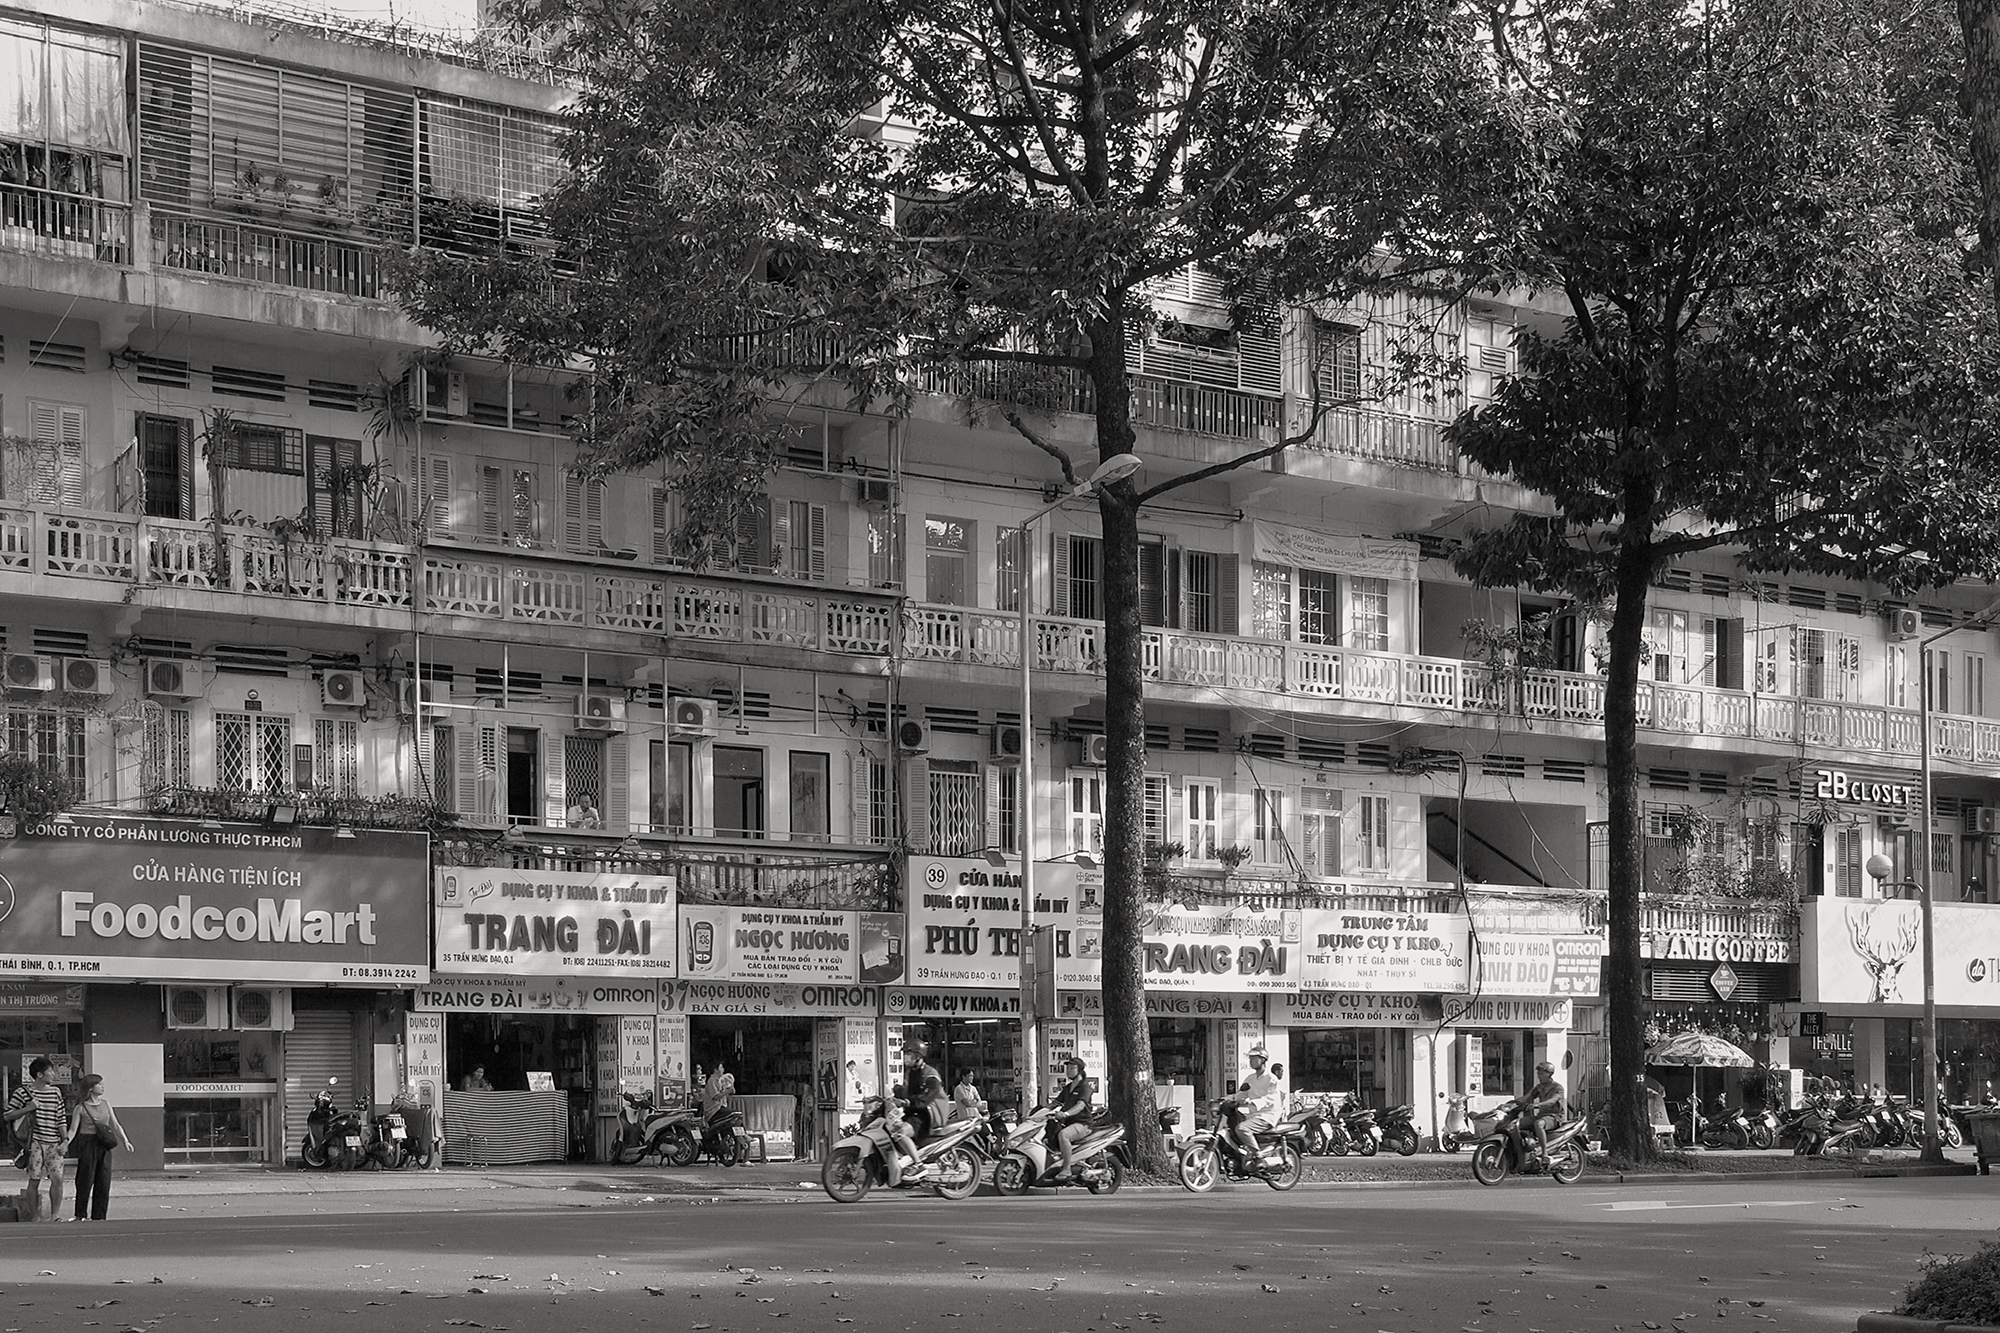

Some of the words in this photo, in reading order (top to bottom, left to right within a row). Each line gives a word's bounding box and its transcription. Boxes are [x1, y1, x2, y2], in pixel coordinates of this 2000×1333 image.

[1817, 769, 1848, 799] 2B
[1850, 781, 1912, 805] CLOSET
[25, 820, 68, 837] CÔNG
[71, 826, 91, 838] TY
[94, 820, 115, 839] CỔ
[118, 823, 158, 841] PHẦN
[160, 829, 210, 844] LƯƠNG
[213, 831, 251, 848] THỰC
[253, 834, 302, 848] TP.HCM
[132, 858, 170, 882] CỬA
[174, 862, 225, 884] HÀNG
[229, 865, 268, 888] TIỆN
[272, 866, 302, 887] ÍCH
[927, 868, 945, 883] 39
[959, 867, 989, 887] CỬA
[992, 871, 1023, 888] HÀN
[501, 882, 534, 901] DỤNG
[536, 884, 553, 902] CỤ
[555, 885, 565, 900] Y
[567, 885, 599, 901] KHOA
[601, 886, 612, 902] &
[649, 885, 668, 904] MỸ
[923, 894, 953, 911] DỤNG
[955, 895, 970, 913] CỤ
[972, 895, 980, 909] Y
[981, 896, 1010, 911] KHOA
[1011, 897, 1020, 912] &
[1052, 896, 1069, 914] MỸ
[60, 890, 378, 946] FoodcoMart
[741, 912, 763, 925] DỤNG
[763, 913, 774, 925] CỤ
[775, 914, 781, 924] Y
[781, 914, 802, 925] KHOA
[802, 915, 809, 926] &
[832, 914, 844, 926] MỸ
[1340, 915, 1394, 930] TRUNG
[1395, 914, 1429, 932] TÂM
[463, 912, 579, 953] TRANG
[597, 908, 652, 955] ĐÀI
[925, 917, 980, 956] PHÚ
[735, 928, 784, 953] NGỌC
[790, 928, 850, 951] HƯƠNG
[1317, 933, 1365, 952] DỤNG
[1366, 935, 1389, 953] CỤ
[1392, 936, 1404, 950] Y
[1518, 942, 1524, 955] Y
[1526, 942, 1550, 956] KHOA
[1555, 941, 1600, 956] OMRON
[1714, 937, 1790, 963] COFFEE
[442, 953, 452, 963] 35
[471, 953, 489, 964] HƯNG
[743, 953, 759, 962] MUA
[760, 953, 776, 962] BÁN
[777, 955, 797, 963] TRAO
[798, 953, 811, 963] ĐỔI
[1236, 938, 1287, 976] ĐÀI
[1306, 952, 1331, 965] THIẾT
[1335, 955, 1344, 966] BỊ
[1347, 956, 1353, 965] Y
[1371, 956, 1386, 966] GIA
[1421, 957, 1442, 967] CHLB
[1446, 956, 1463, 968] ĐỨC
[21, 958, 45, 971] BÌNH,
[68, 961, 100, 972] TP.HCM
[747, 961, 762, 970] CÁC
[763, 963, 780, 972] LOẠI
[781, 963, 801, 973] DỤNG
[801, 964, 812, 973] CỤ
[1516, 958, 1549, 983] ĐÀO
[342, 967, 357, 977] ĐT:
[358, 967, 393, 978] 08.3914
[394, 969, 417, 979] 2242
[917, 967, 929, 979] 39
[950, 970, 970, 980] HƯNG
[970, 971, 986, 982] ĐẠO
[444, 978, 455, 988] CỤ
[463, 978, 485, 987] KHOA
[1258, 980, 1271, 988] 090
[1271, 980, 1285, 988] 3003
[1286, 981, 1297, 989] 565
[1303, 980, 1312, 989] 43
[25, 993, 59, 1006] TRƯỜNG
[421, 991, 485, 1007] TRANG
[490, 988, 523, 1008] ĐÀI
[593, 987, 655, 1003] OMRON
[661, 980, 690, 1012] 37
[690, 984, 725, 1001] NGỌC
[727, 983, 771, 999] HƯƠNG
[801, 985, 876, 1007] OMRON
[1286, 993, 1334, 1010] DỤNG
[1338, 994, 1361, 1010] CỤ
[1365, 995, 1377, 1009] Y
[691, 1001, 720, 1013] BÁN
[724, 1002, 749, 1013] GIÁ
[890, 994, 904, 1007] 39
[909, 995, 940, 1015] DỤNG
[942, 995, 958, 1015] CỤ
[959, 996, 969, 1011] Y
[970, 997, 1000, 1012] KHOA
[1001, 1001, 1009, 1012] &
[1194, 997, 1232, 1014] ĐÀI
[1241, 1000, 1258, 1013] 41
[1292, 1011, 1313, 1020] MUA
[1315, 1010, 1334, 1020] BÁN
[1342, 1012, 1364, 1021] TRAO
[1367, 1010, 1382, 1021] ĐỔI
[1390, 1011, 1402, 1021] KÝ
[1447, 1004, 1461, 1018] 45
[1465, 1001, 1493, 1024] DỤNG
[1496, 1002, 1510, 1025] CỤ
[1513, 1002, 1520, 1020] Y
[1523, 1002, 1550, 1021] KHOA
[1806, 1013, 1817, 1024] THE
[409, 1017, 429, 1030] DỤNG
[430, 1017, 440, 1030] CỤ
[623, 1020, 642, 1032] DỤNG
[642, 1020, 652, 1032] CỤ
[1803, 1024, 1820, 1035] ALLEY
[412, 1033, 418, 1044] Y
[419, 1033, 438, 1044] KHOA
[625, 1035, 631, 1046] Y
[632, 1035, 650, 1046] KHOA
[1050, 1038, 1066, 1050] DỤNG
[422, 1049, 428, 1060] &
[635, 1050, 641, 1061] &
[409, 1060, 429, 1076] THẨM
[430, 1062, 441, 1076] MỸ
[623, 1061, 642, 1076] THẨM
[643, 1063, 653, 1076] MỸ
[1636, 1074, 1645, 1083] 15
[175, 1084, 244, 1092] FOODCOMART
